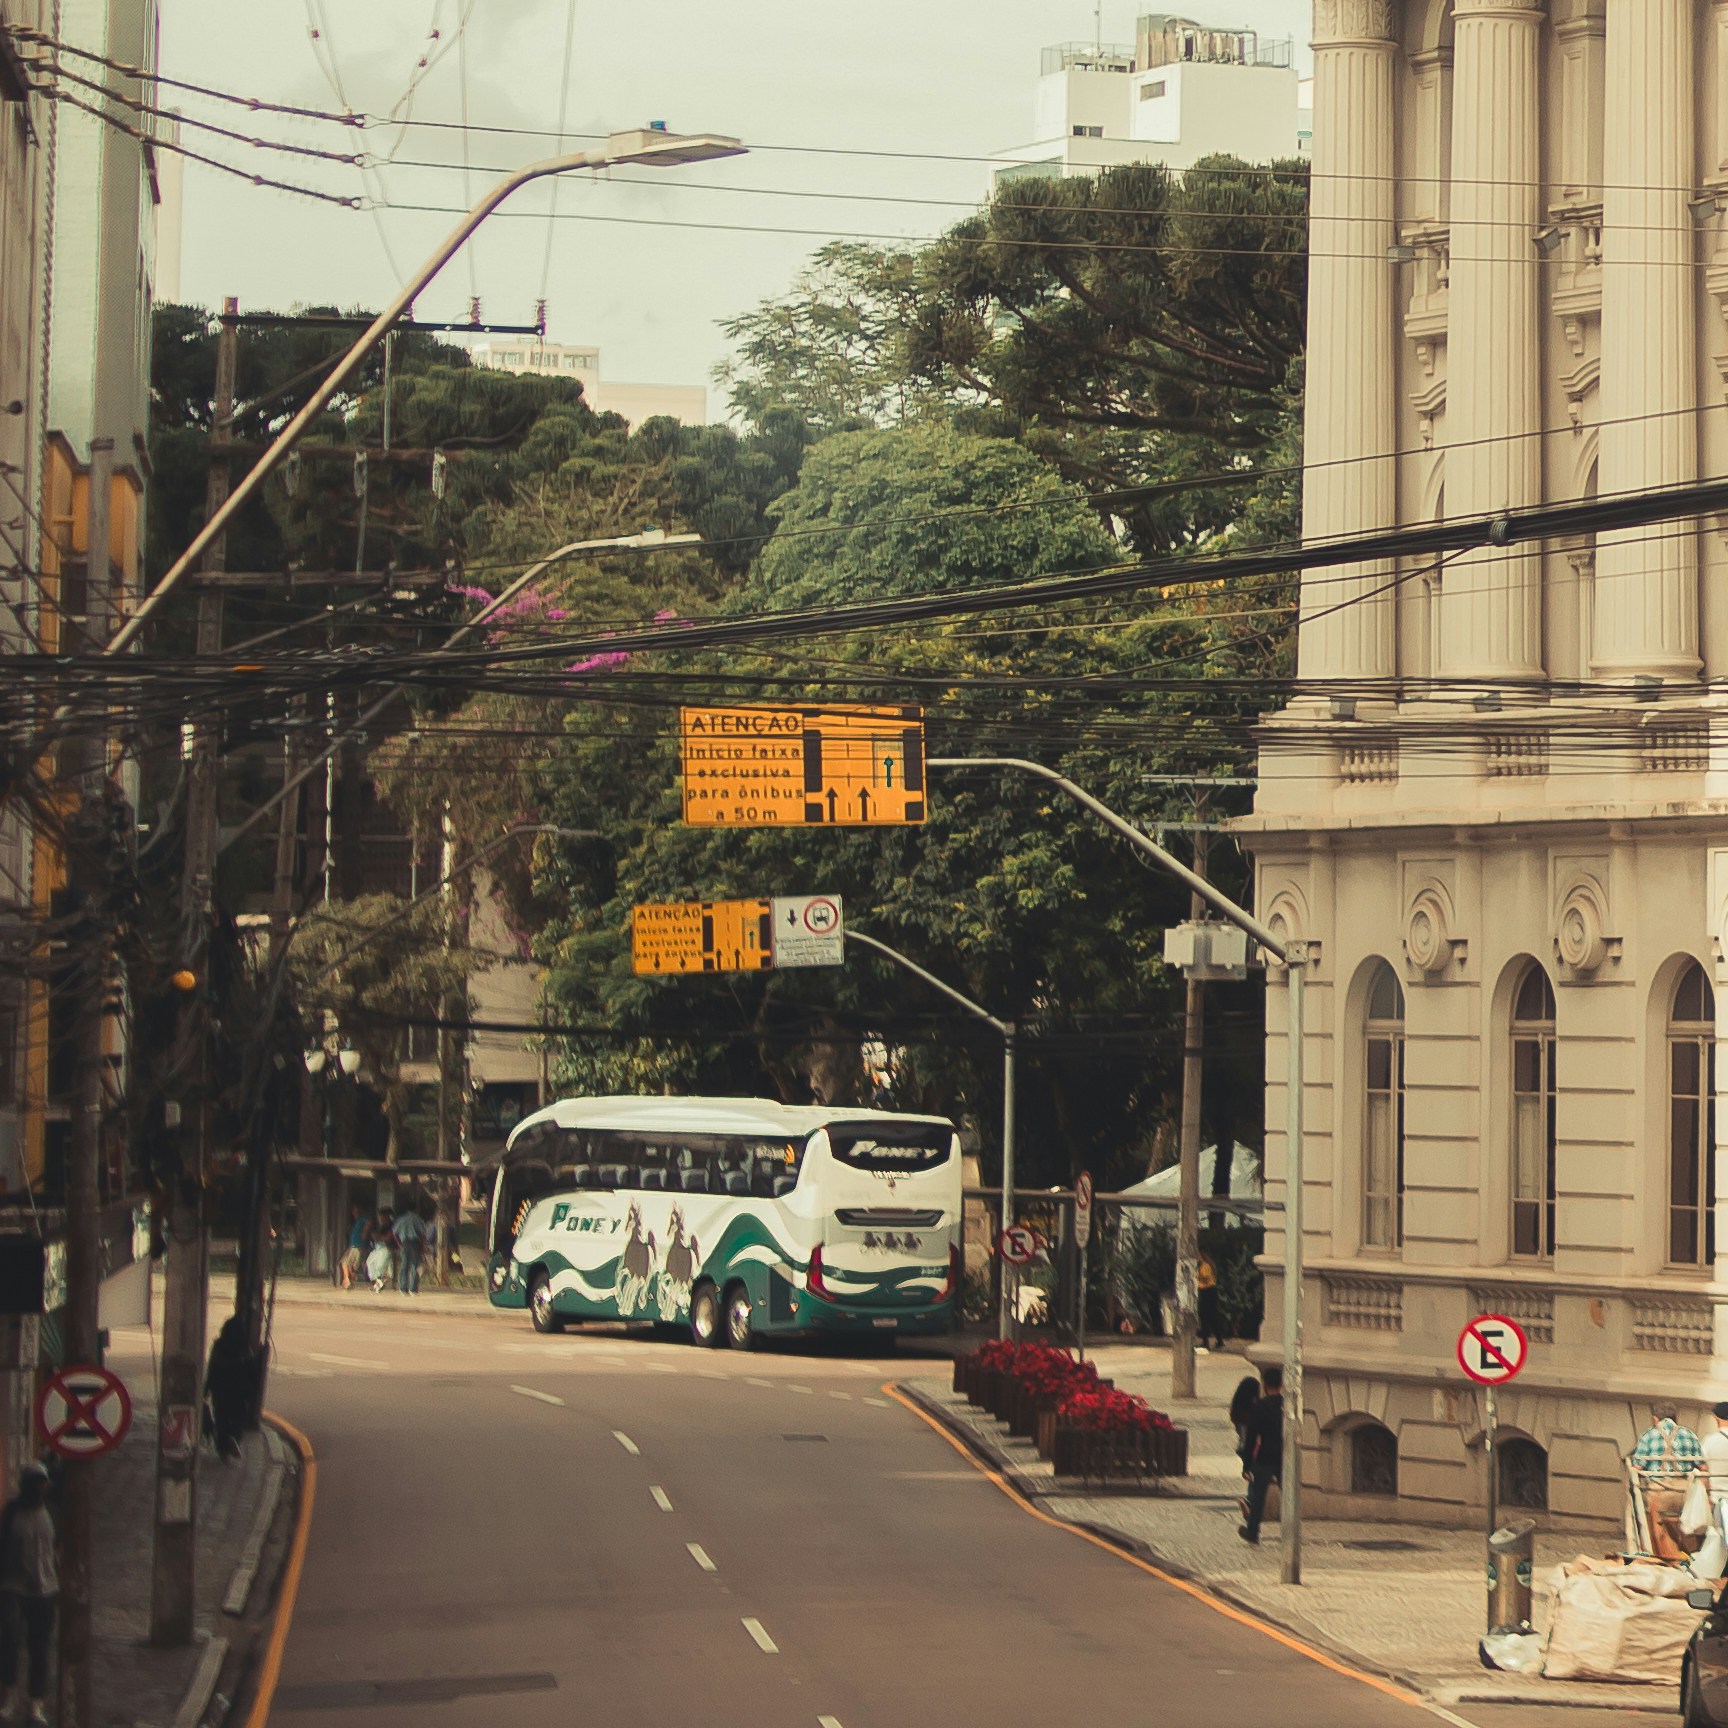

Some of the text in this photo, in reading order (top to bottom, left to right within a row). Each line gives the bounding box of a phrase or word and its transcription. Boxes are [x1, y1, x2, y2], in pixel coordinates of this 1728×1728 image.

[688, 785, 803, 801] para ônibus
[1480, 1330, 1504, 1369] E
